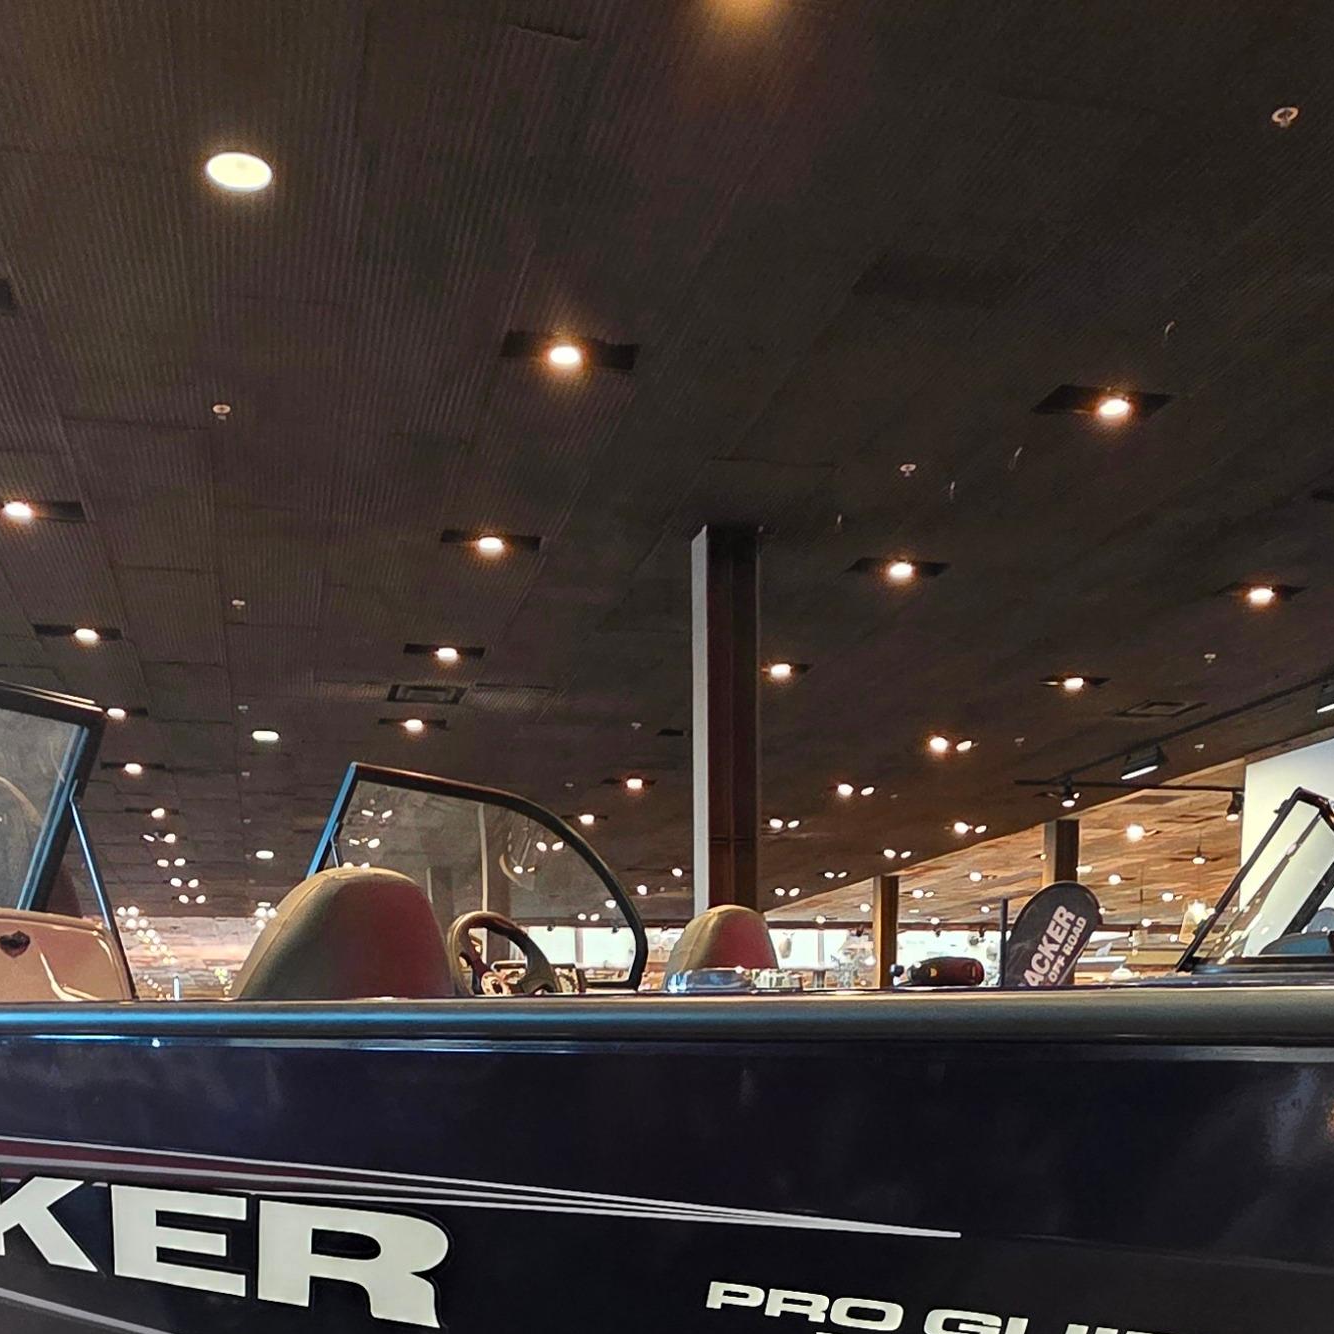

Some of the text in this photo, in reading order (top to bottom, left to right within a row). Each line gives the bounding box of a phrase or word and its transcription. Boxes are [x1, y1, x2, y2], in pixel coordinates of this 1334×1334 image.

[1017, 905, 1076, 987] ACKER
[1047, 916, 1087, 983] OFF ROAD
[706, 1281, 904, 1331] PRO
